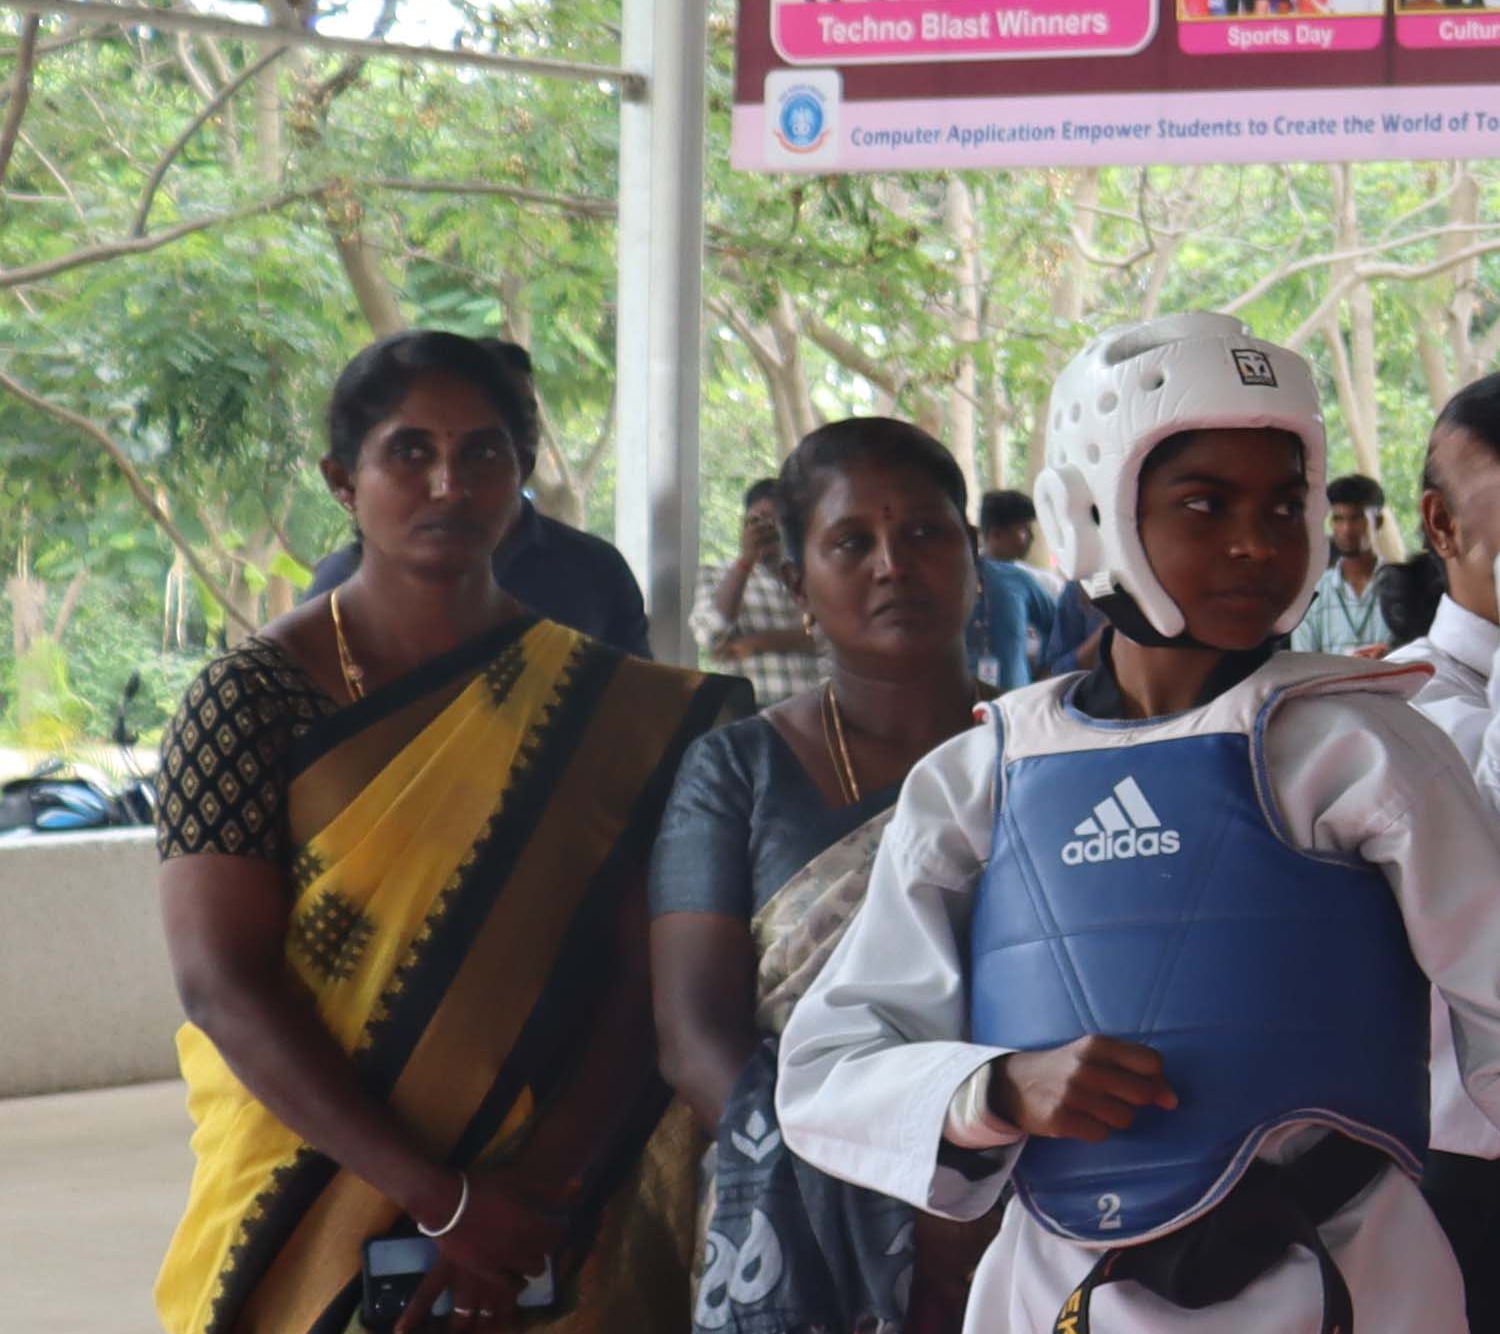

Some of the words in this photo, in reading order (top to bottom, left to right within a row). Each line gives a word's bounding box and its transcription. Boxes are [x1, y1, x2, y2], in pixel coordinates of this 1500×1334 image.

[818, 14, 915, 45] Techno
[921, 11, 990, 41] Blast
[996, 9, 1110, 38] Winners
[1228, 25, 1289, 50] Sports
[1296, 24, 1334, 49] Day
[851, 127, 941, 150] Computer
[945, 123, 1055, 149] Application
[1061, 120, 1150, 145] Empower
[1157, 117, 1242, 140] Students
[1247, 120, 1268, 137] to
[1273, 114, 1338, 137] Create
[1343, 114, 1376, 135] the
[1381, 112, 1444, 135] World
[1449, 112, 1470, 134] of
[1061, 827, 1181, 865] adidas
[1098, 1193, 1122, 1229] 2
